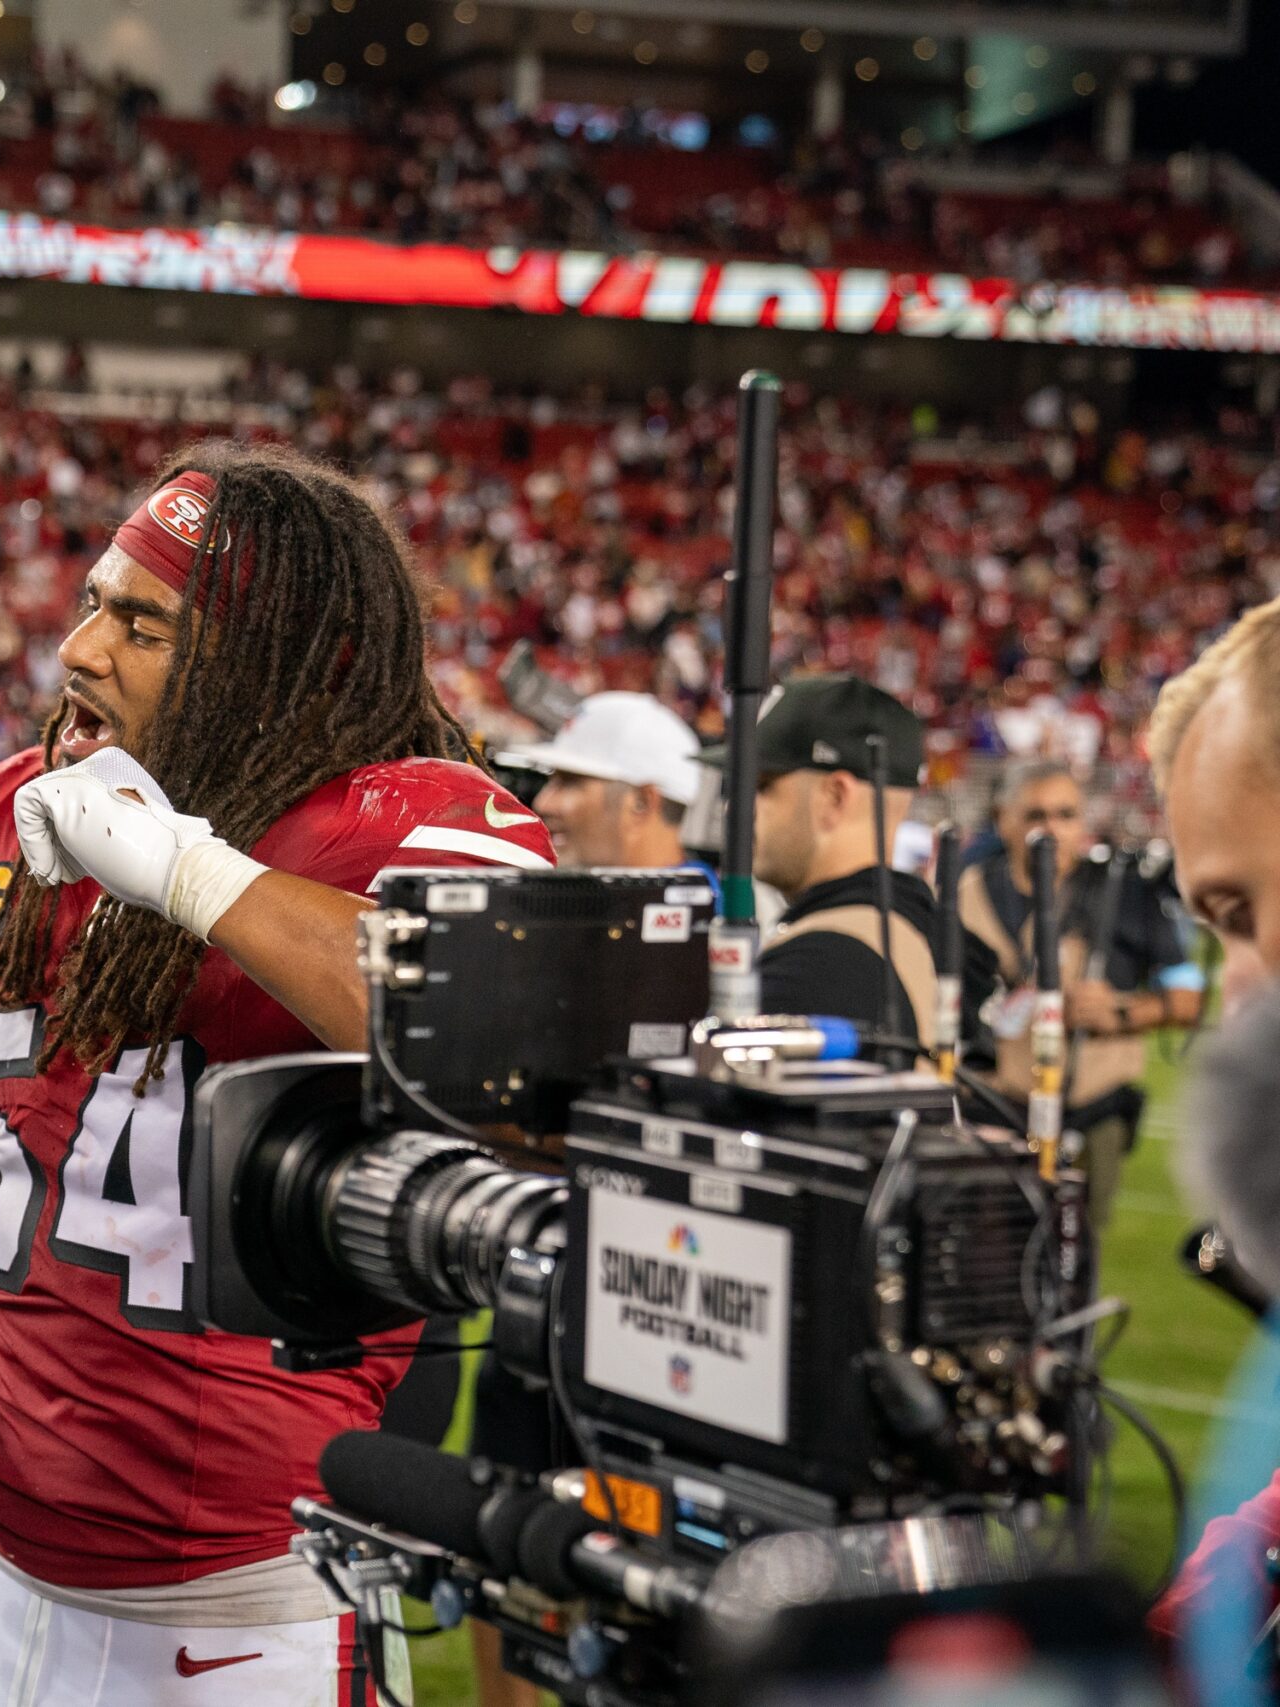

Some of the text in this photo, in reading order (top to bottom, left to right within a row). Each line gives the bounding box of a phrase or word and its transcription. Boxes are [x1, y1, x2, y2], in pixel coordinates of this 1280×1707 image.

[599, 1246, 769, 1336] SUNDAY NIGHT
[621, 1304, 746, 1361] FOOTBALL
